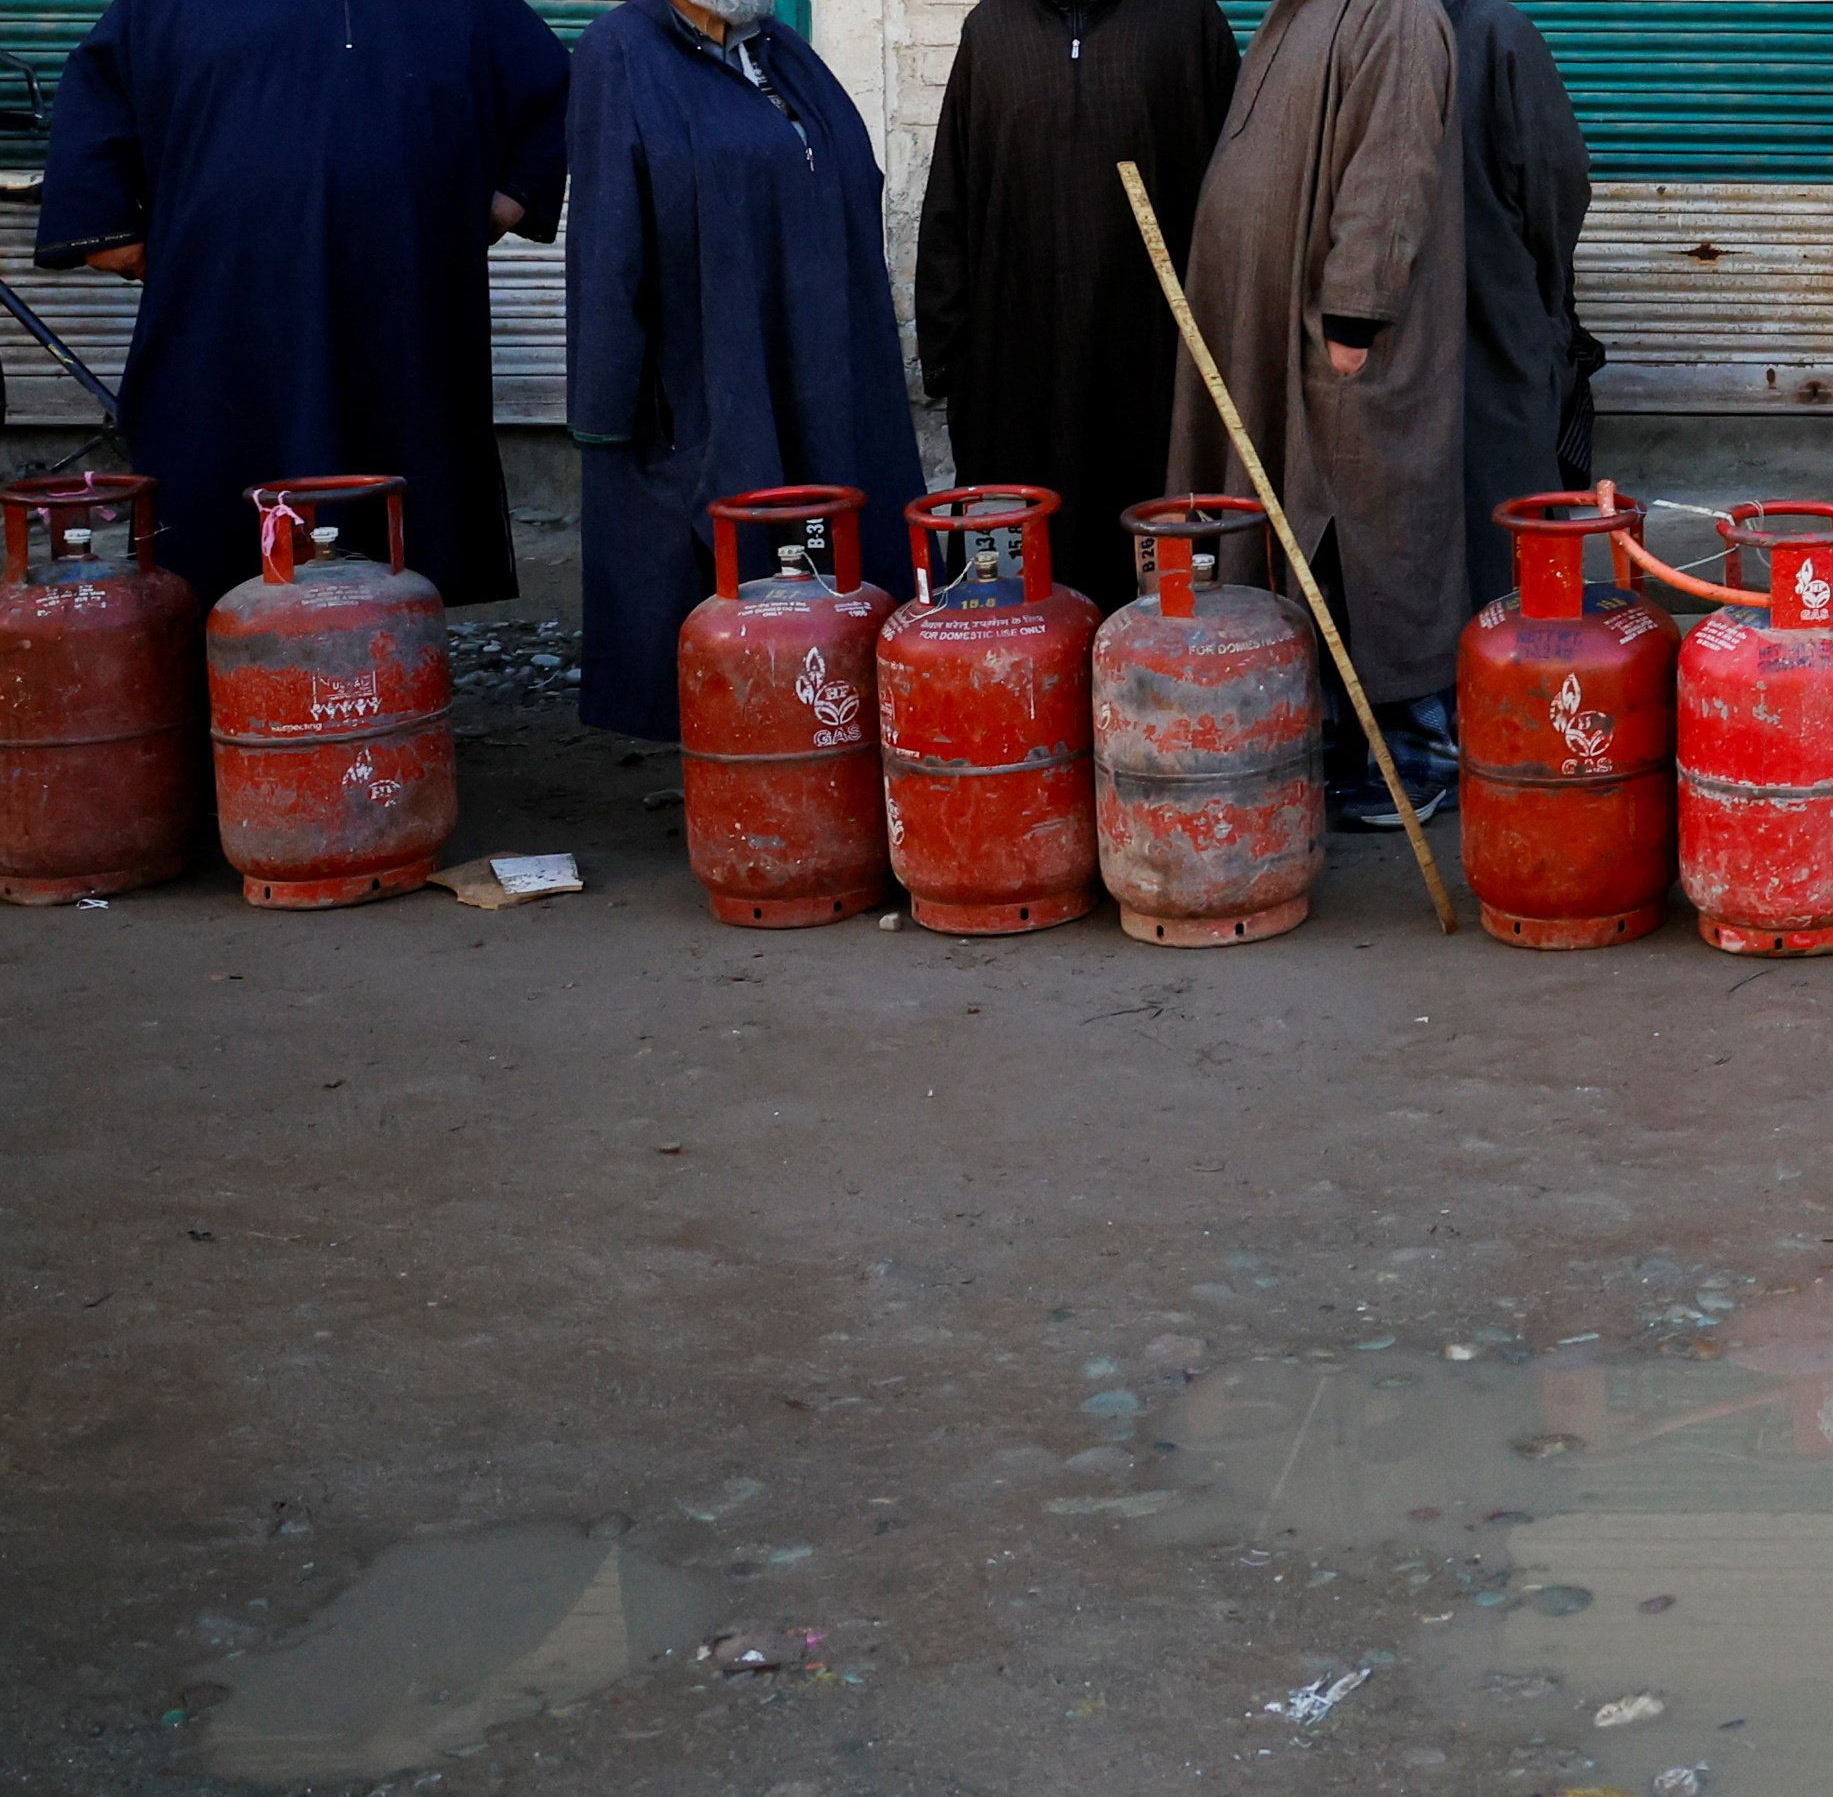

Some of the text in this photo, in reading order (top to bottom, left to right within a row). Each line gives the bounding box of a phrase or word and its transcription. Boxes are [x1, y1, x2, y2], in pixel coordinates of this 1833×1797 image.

[939, 629, 993, 641] DOMESTIC
[1019, 624, 1046, 635] ONLY
[813, 723, 862, 747] GAS
